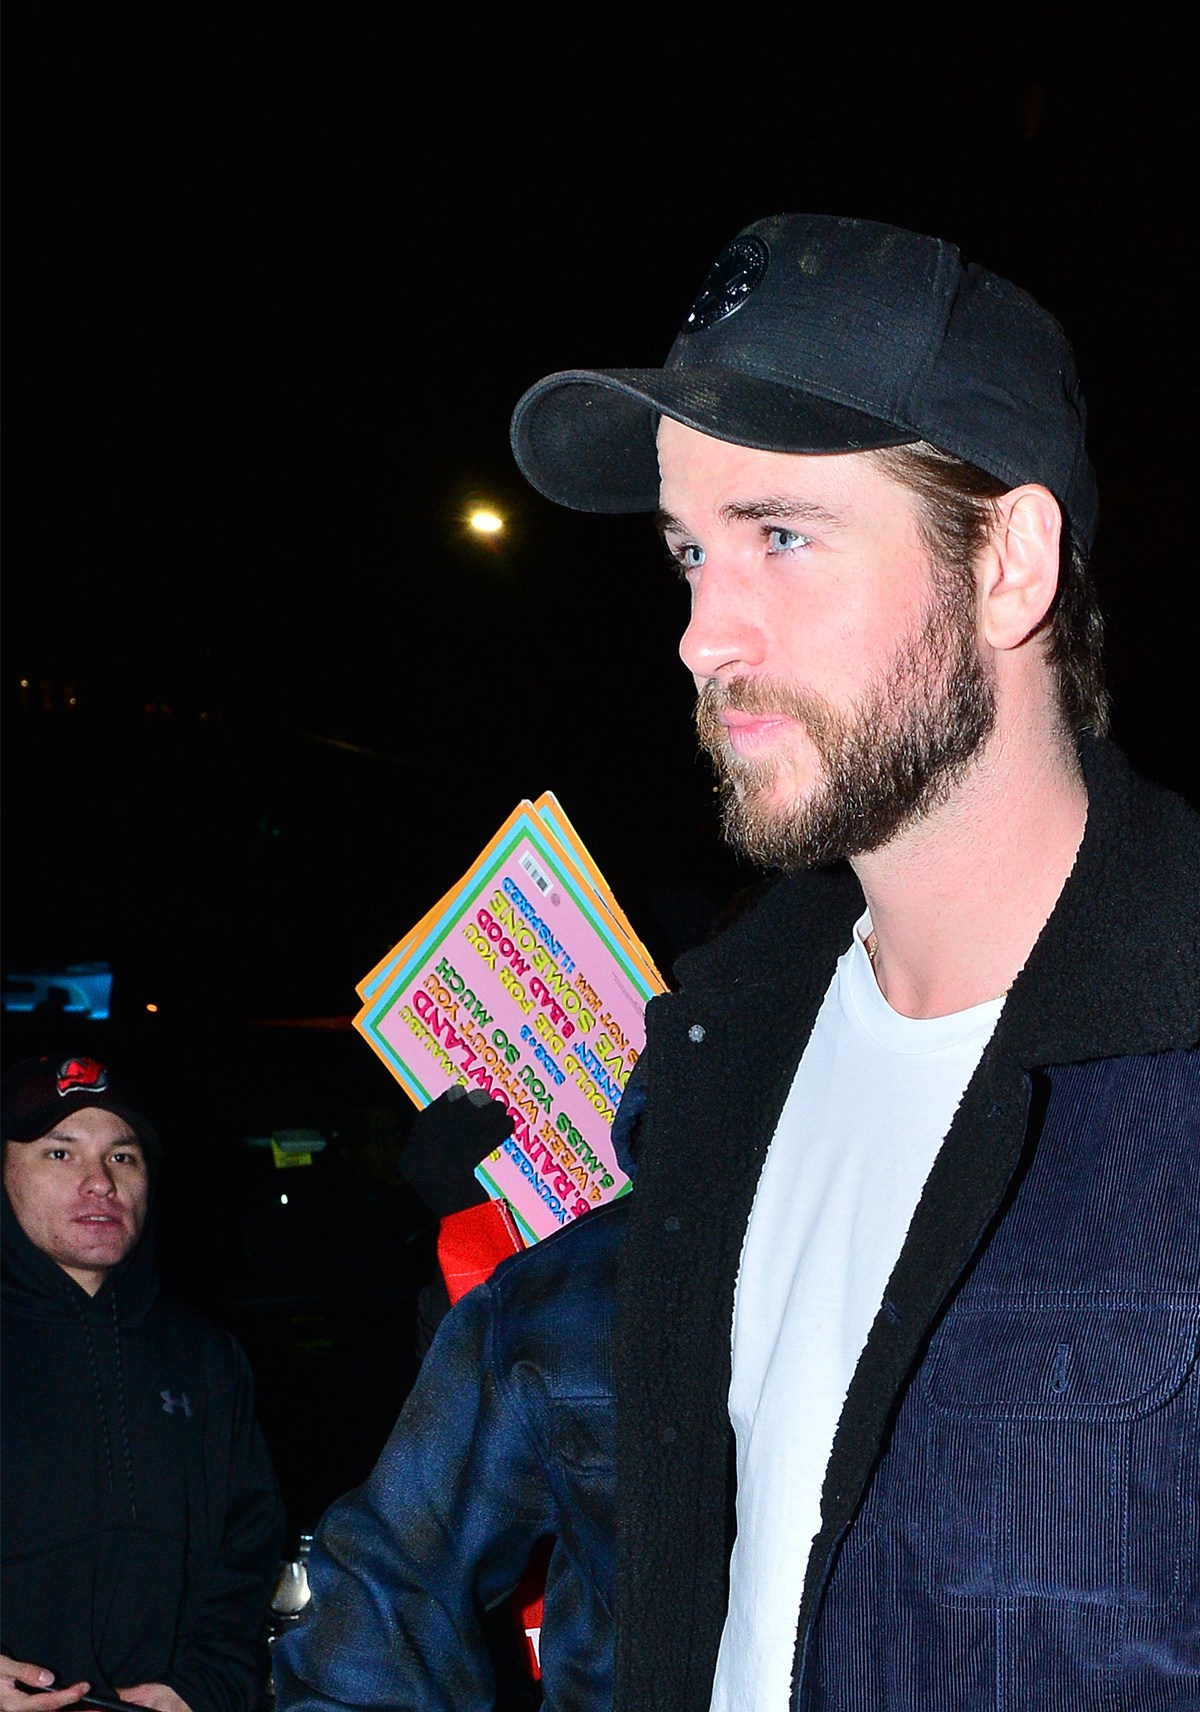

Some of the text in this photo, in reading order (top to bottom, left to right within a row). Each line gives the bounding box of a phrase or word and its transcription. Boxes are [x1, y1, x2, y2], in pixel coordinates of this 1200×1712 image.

[463, 923, 499, 971] YOU
[476, 909, 531, 977] MOOD
[502, 877, 576, 974] 11.INSPIRED
[488, 890, 596, 1035] SOMEONE
[496, 965, 536, 1015] FOR
[574, 972, 603, 1013] HIM
[527, 976, 575, 1039] 8.BAD
[534, 1012, 566, 1056] DIE
[599, 1012, 630, 1051] NOT
[423, 973, 602, 1203] 4.WEEK WITHOUT YOU
[435, 957, 615, 1190] 5.MISS YOU SO MUCH
[398, 1005, 571, 1224] .YOUNGER 2.MALIBU
